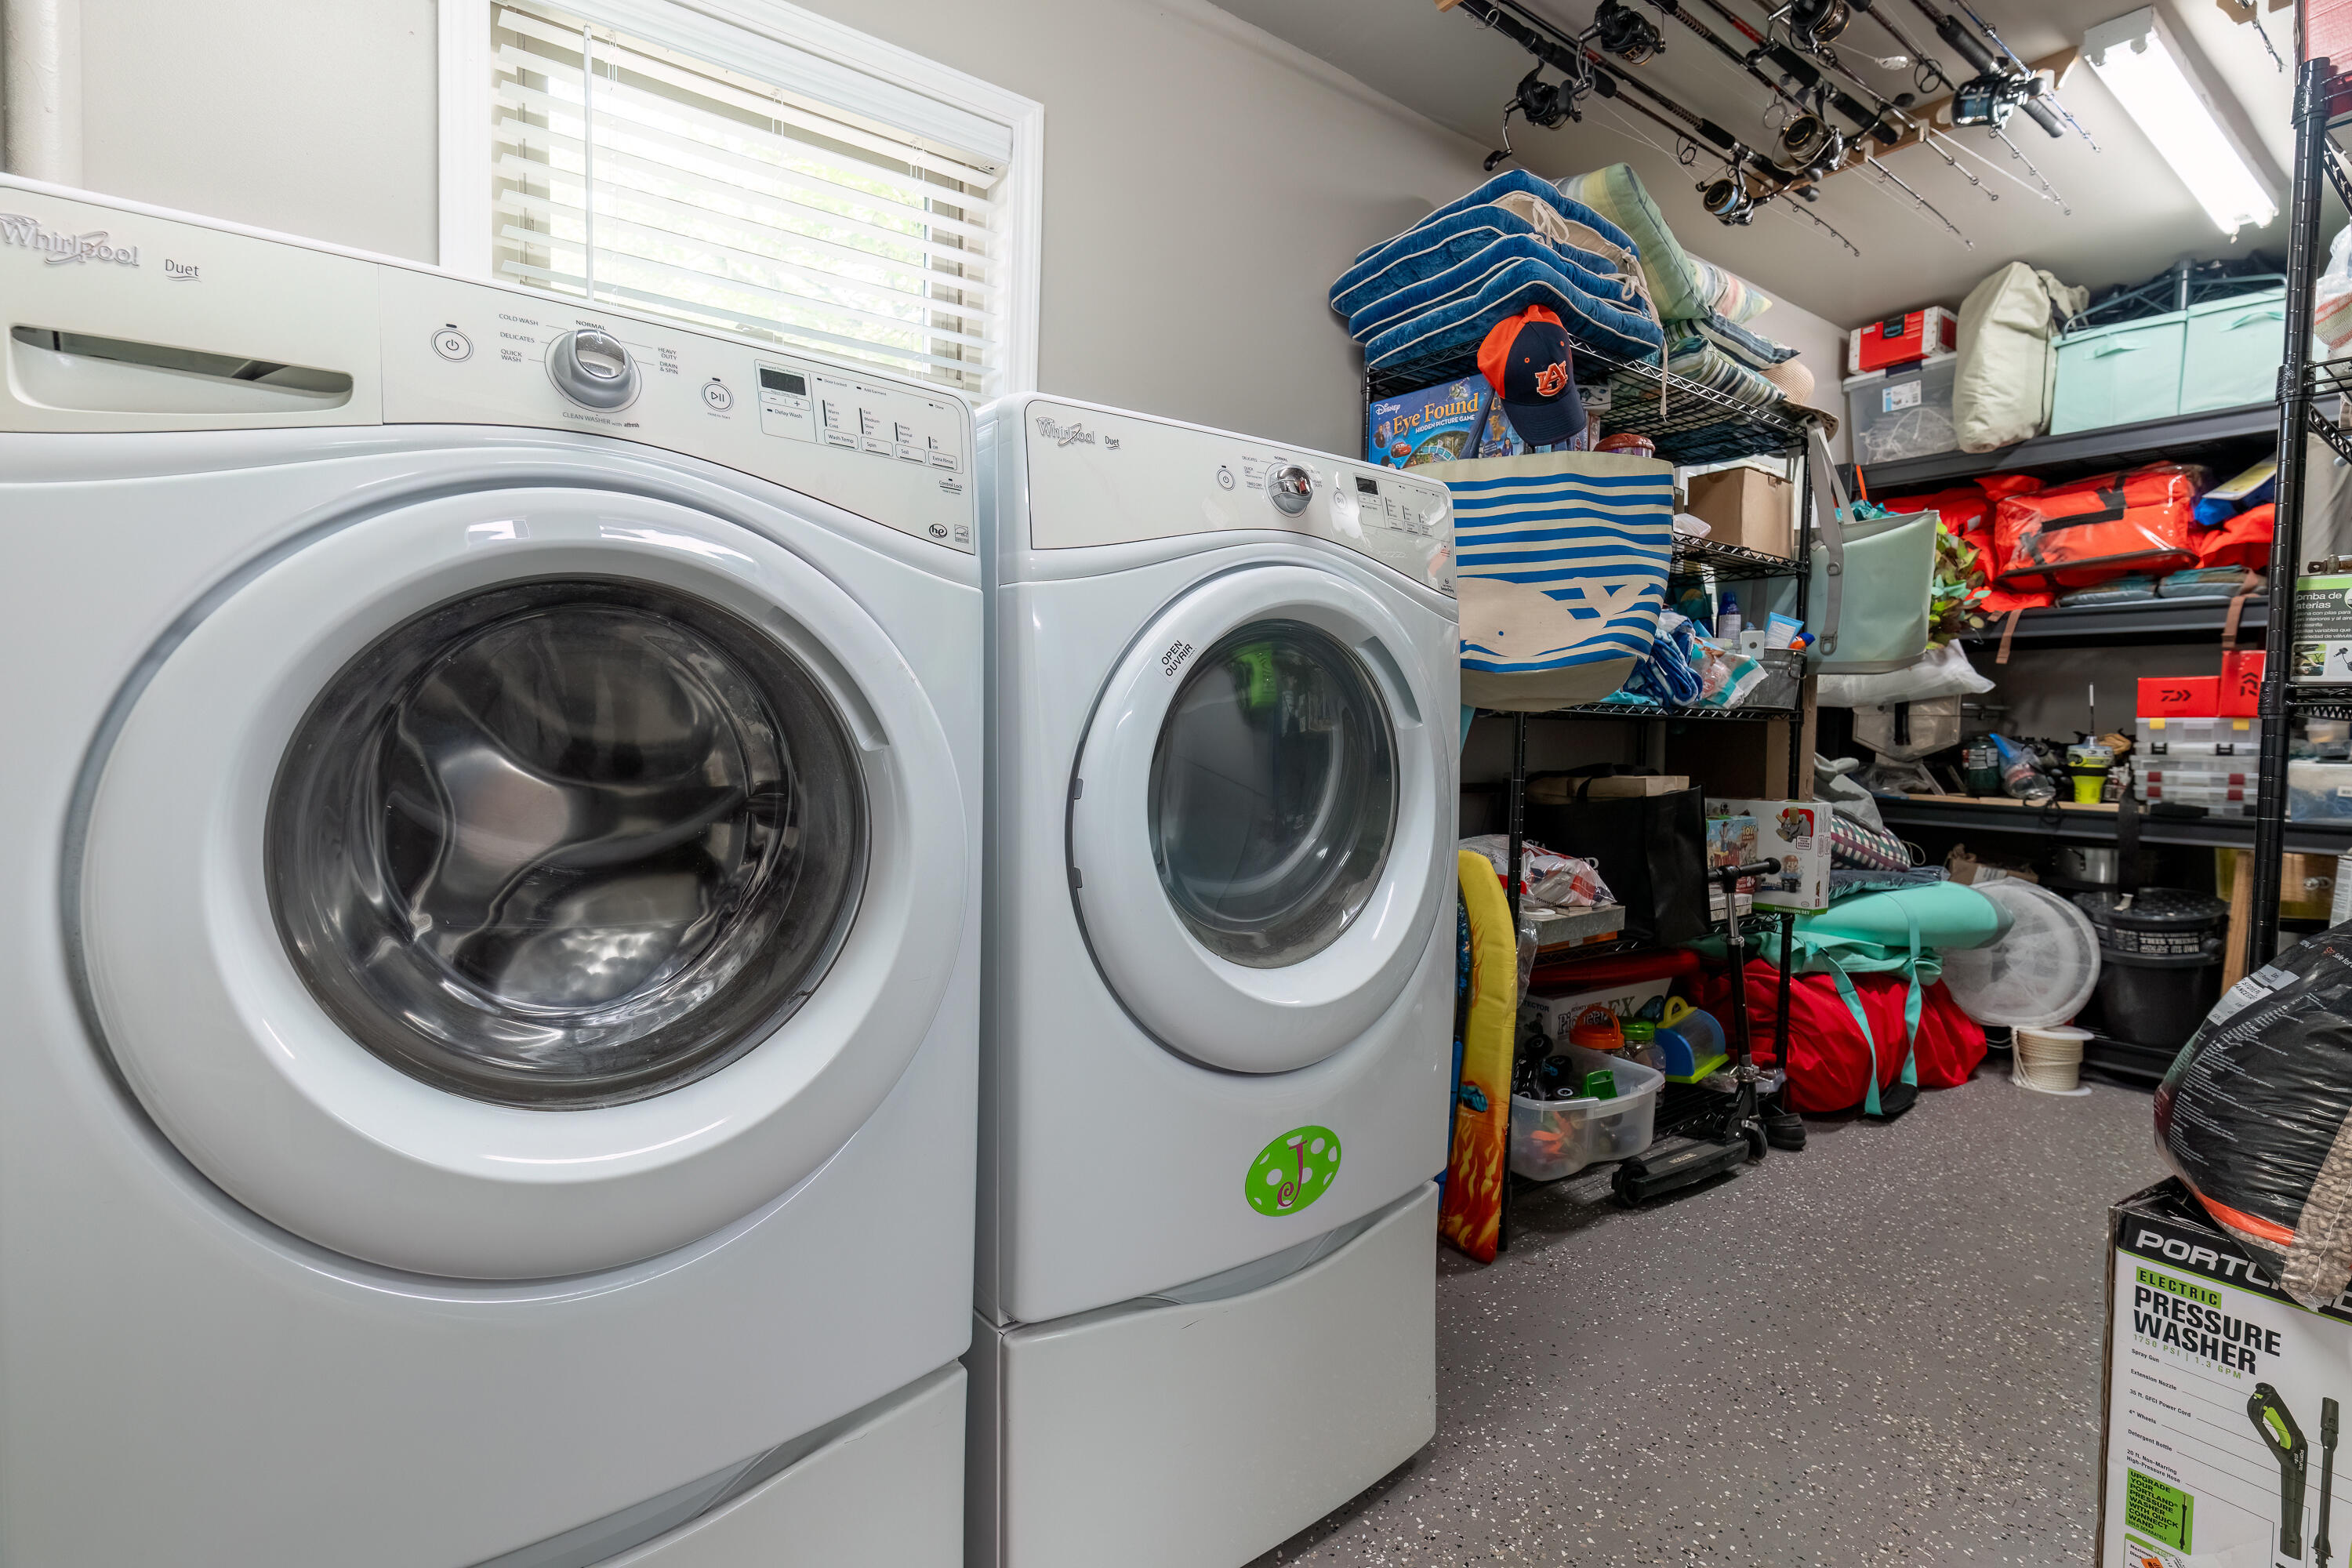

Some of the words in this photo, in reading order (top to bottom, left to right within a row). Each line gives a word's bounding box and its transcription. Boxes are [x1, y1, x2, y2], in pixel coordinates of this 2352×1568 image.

[0, 213, 140, 267] Whirlpool
[165, 258, 200, 278] Duet
[499, 314, 518, 322] COLD
[518, 316, 539, 326] WASH
[575, 320, 606, 331] NORMAL
[499, 332, 535, 343] DELICATES
[500, 349, 522, 358] QUICK
[501, 354, 521, 363] WASH
[562, 412, 585, 420] CLEAN
[585, 415, 611, 425] WASHER
[1392, 413, 1421, 437] Eye
[1423, 392, 1479, 423] Found
[1036, 416, 1095, 447] Whirlpool
[1415, 423, 1436, 434] HIDDEN
[1436, 417, 1459, 428] PICTURE
[1105, 435, 1120, 446] Duet
[2296, 592, 2325, 601] omba
[2328, 591, 2343, 600] de
[1161, 640, 1183, 665] OPEN
[1165, 644, 1193, 677] OUVRIR
[1741, 825, 1755, 836] TOY
[1523, 1000, 1550, 1012] TECTOR
[1277, 1140, 1308, 1207] J
[2140, 1269, 2218, 1306] ELECTRIC
[2134, 1284, 2281, 1357] PRESSURE
[2133, 1308, 2256, 1375] WASHER
[2131, 1348, 2147, 1359] Spray
[2148, 1354, 2160, 1363] Gun
[2133, 1334, 2158, 1348] 1750
[2163, 1344, 2180, 1356] PSI
[2195, 1356, 2212, 1369] 1.3
[2217, 1365, 2241, 1380] GPM
[2130, 1368, 2158, 1383] Extension
[2158, 1379, 2177, 1391] Nozzle
[2145, 1394, 2158, 1404] GFCI
[2158, 1400, 2176, 1412] Power
[2177, 1407, 2191, 1418] Cord
[2136, 1411, 2157, 1425] Wheels
[2128, 1428, 2154, 1445] Detergent
[2155, 1439, 2172, 1452] Bottle
[2126, 1455, 2165, 1477] High-Pressure
[2166, 1472, 2181, 1484] Hose
[2142, 1454, 2177, 1475] Non-Marring
[2130, 1471, 2172, 1494] UPGRADE
[2130, 1476, 2154, 1492] YOUR
[2129, 1489, 2174, 1513] PRESSURE
[2129, 1495, 2165, 1516] WASHER
[2128, 1513, 2154, 1530] WAND
[2129, 1501, 2150, 1515] WITH
[2151, 1511, 2179, 1529] QUICK
[2129, 1507, 2169, 1530] CONNECT
[2128, 1520, 2140, 1529] SOLD
[2140, 1525, 2167, 1541] SEPARATELY
[2129, 1551, 2143, 1560] Disch
[2130, 1544, 2154, 1559] Maximum
